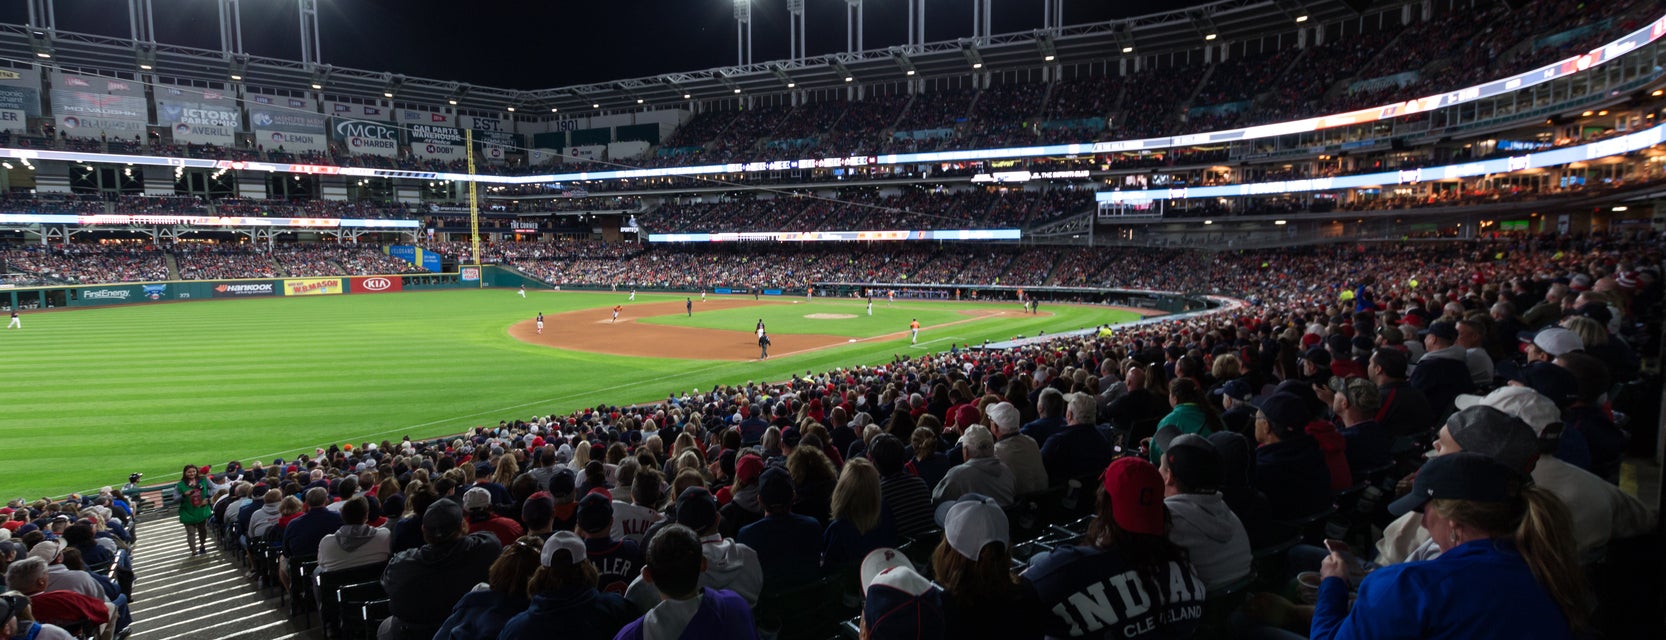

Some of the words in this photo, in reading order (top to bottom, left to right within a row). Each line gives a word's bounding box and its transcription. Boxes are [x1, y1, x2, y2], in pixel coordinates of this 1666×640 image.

[181, 117, 208, 126] PARK
[472, 117, 503, 131] EST.
[556, 120, 578, 132] 1901
[191, 127, 231, 137] AVERILL
[413, 125, 431, 133] CAR
[432, 127, 459, 135] PARTS
[285, 135, 314, 145] LEMON
[411, 131, 462, 141] WAREHOUSE
[363, 139, 395, 150] HARDER
[436, 146, 454, 154] DOBY
[367, 279, 388, 288] KIA
[83, 288, 130, 299] FirstEnergy
